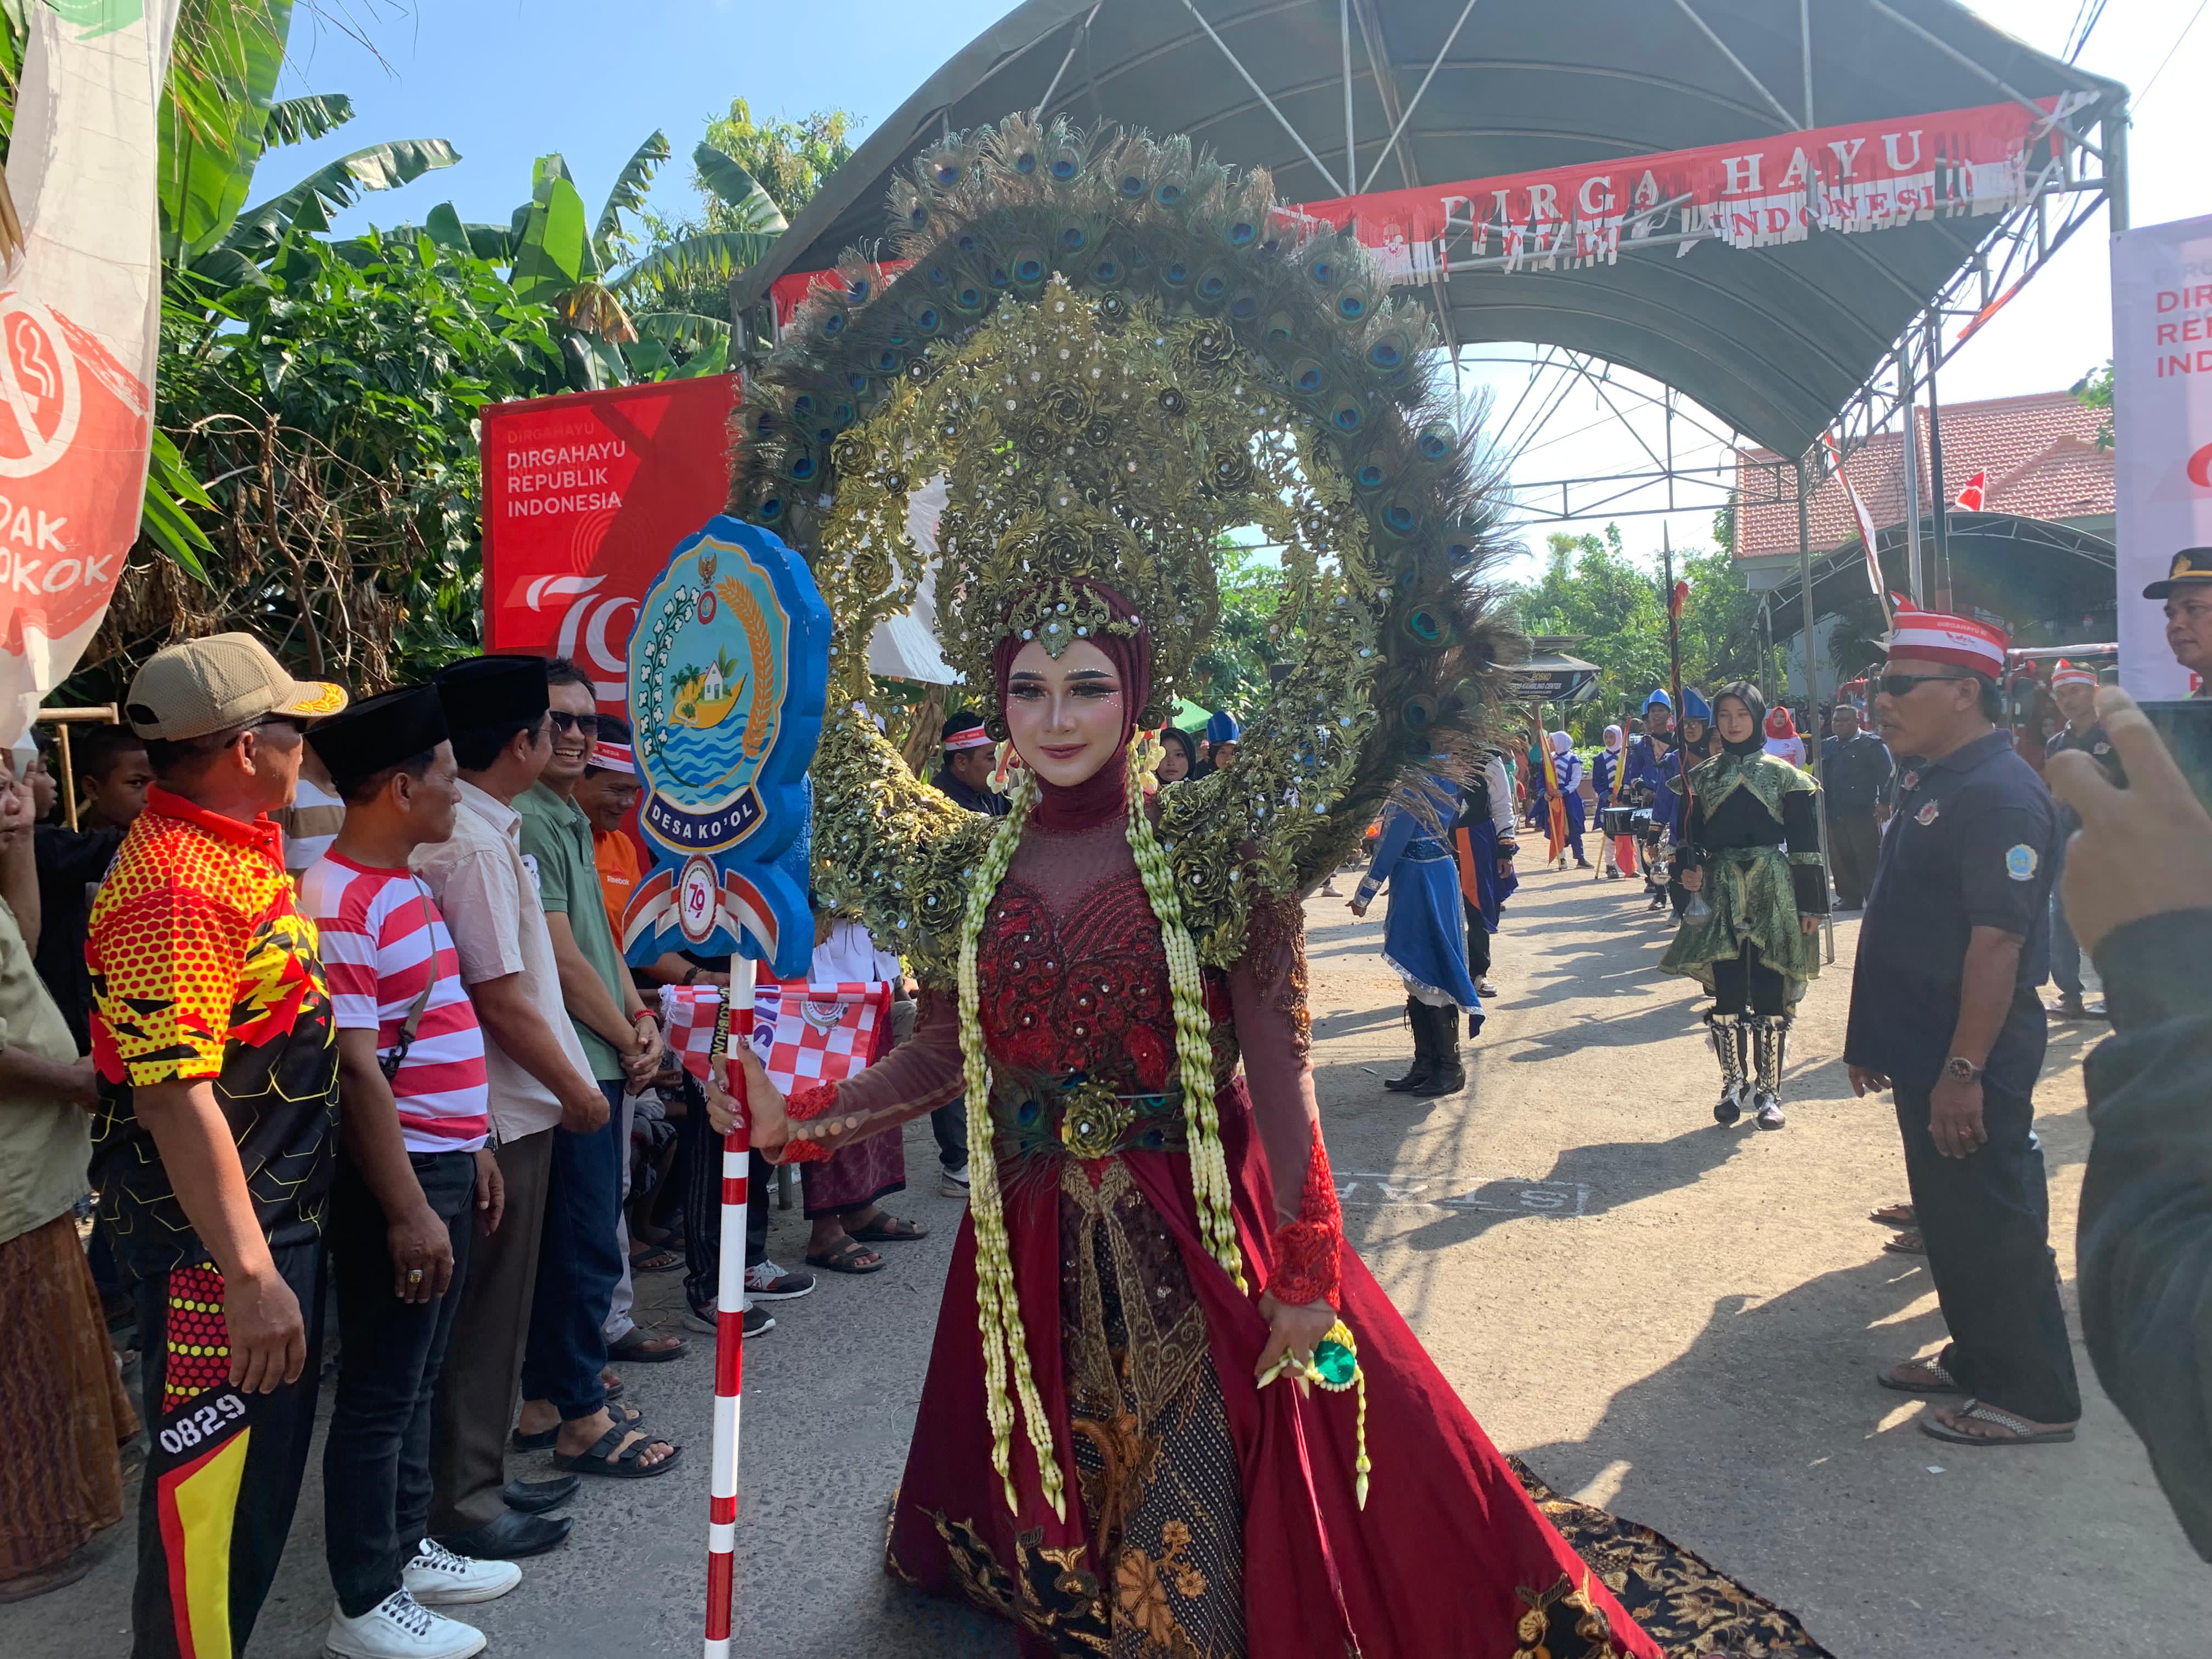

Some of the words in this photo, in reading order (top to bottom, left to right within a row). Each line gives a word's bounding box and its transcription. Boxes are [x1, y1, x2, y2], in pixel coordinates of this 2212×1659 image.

[1722, 130, 1922, 195] HAYU
[507, 440, 626, 470] DIRGAHAYU
[508, 467, 608, 494] REPUBLIK
[509, 491, 623, 518] INDONESIA
[652, 804, 692, 839] DESA
[698, 803, 753, 839] KO'OL
[607, 875, 630, 886] Reebok
[160, 1393, 246, 1454] 0829
